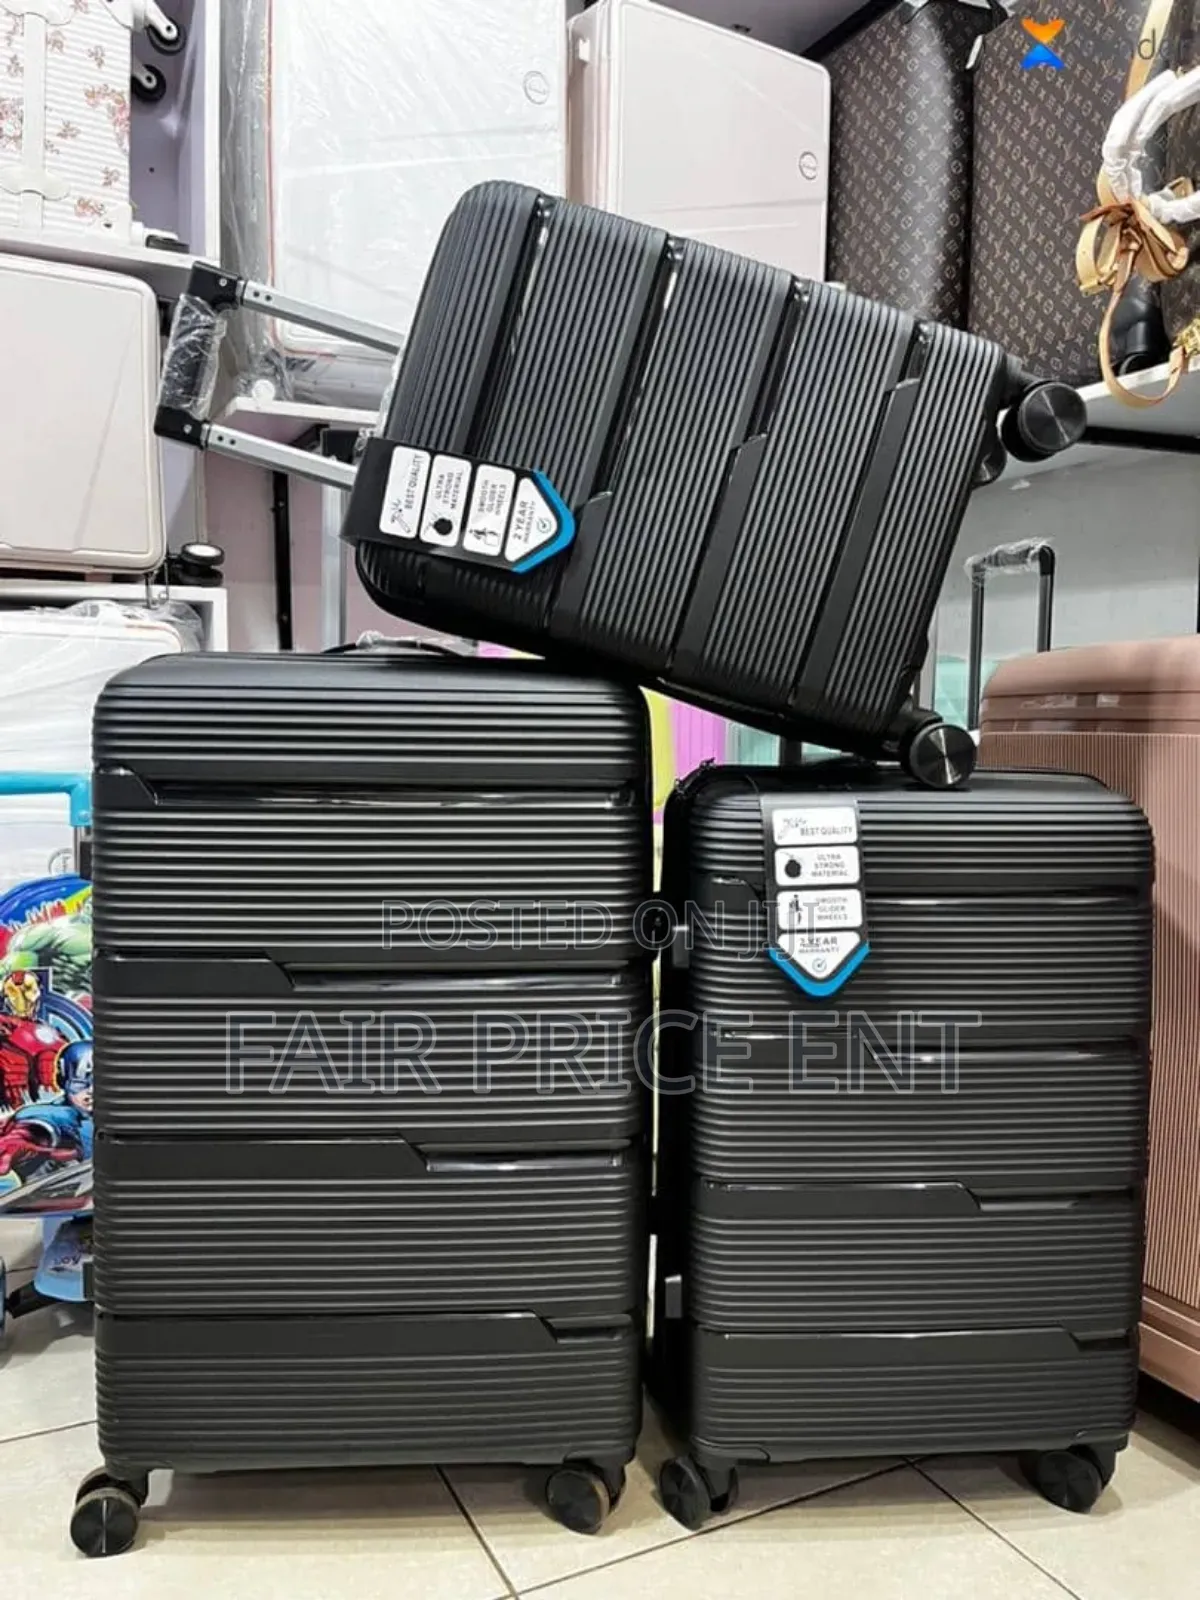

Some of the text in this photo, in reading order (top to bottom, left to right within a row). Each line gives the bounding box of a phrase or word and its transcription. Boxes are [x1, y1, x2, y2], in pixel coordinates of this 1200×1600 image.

[408, 454, 424, 488] QUALITY
[515, 500, 528, 530] YEAR
[800, 826, 853, 836] BEST QUALITY
